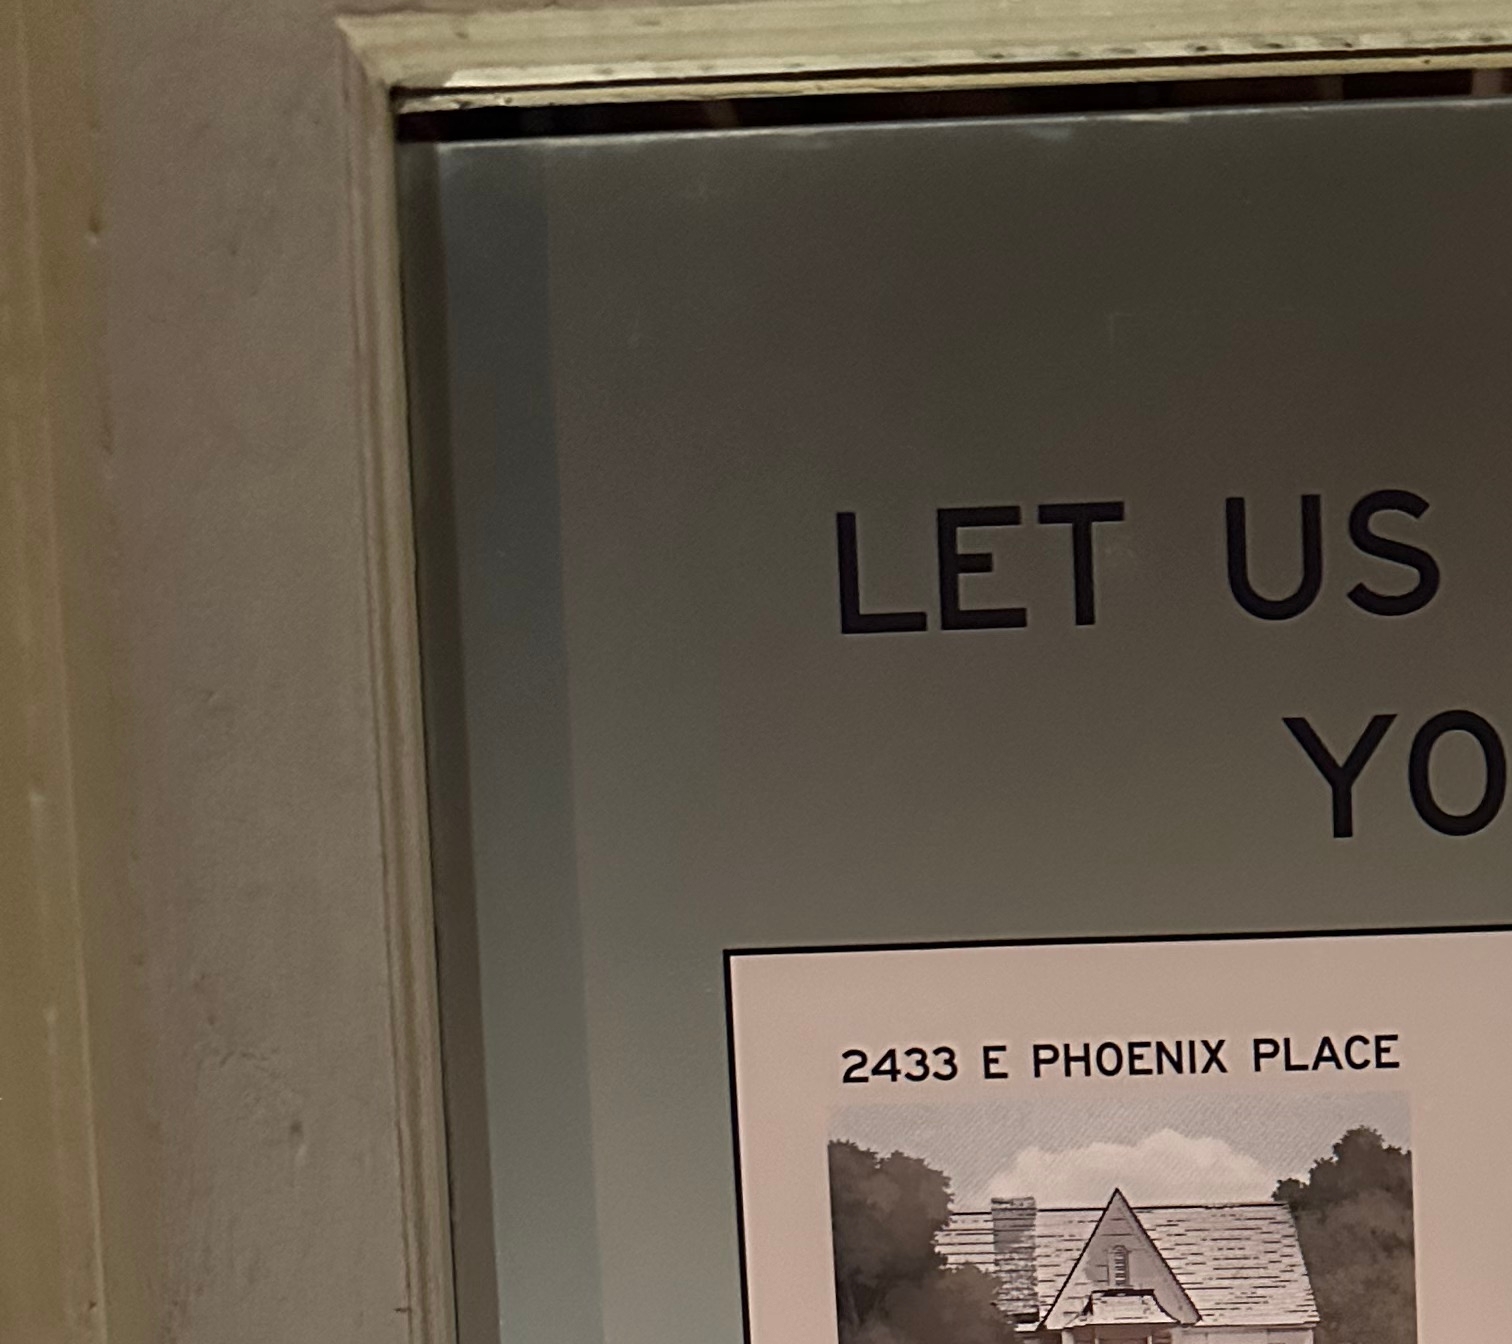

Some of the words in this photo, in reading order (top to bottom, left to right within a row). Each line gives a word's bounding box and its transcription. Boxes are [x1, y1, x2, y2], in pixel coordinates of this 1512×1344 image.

[835, 500, 1125, 635] LET
[1225, 488, 1441, 621] US
[841, 1046, 958, 1084] 2433
[982, 1045, 1009, 1080] E
[1032, 1039, 1228, 1079] PHOENIX
[1253, 1034, 1400, 1073] PLACE
